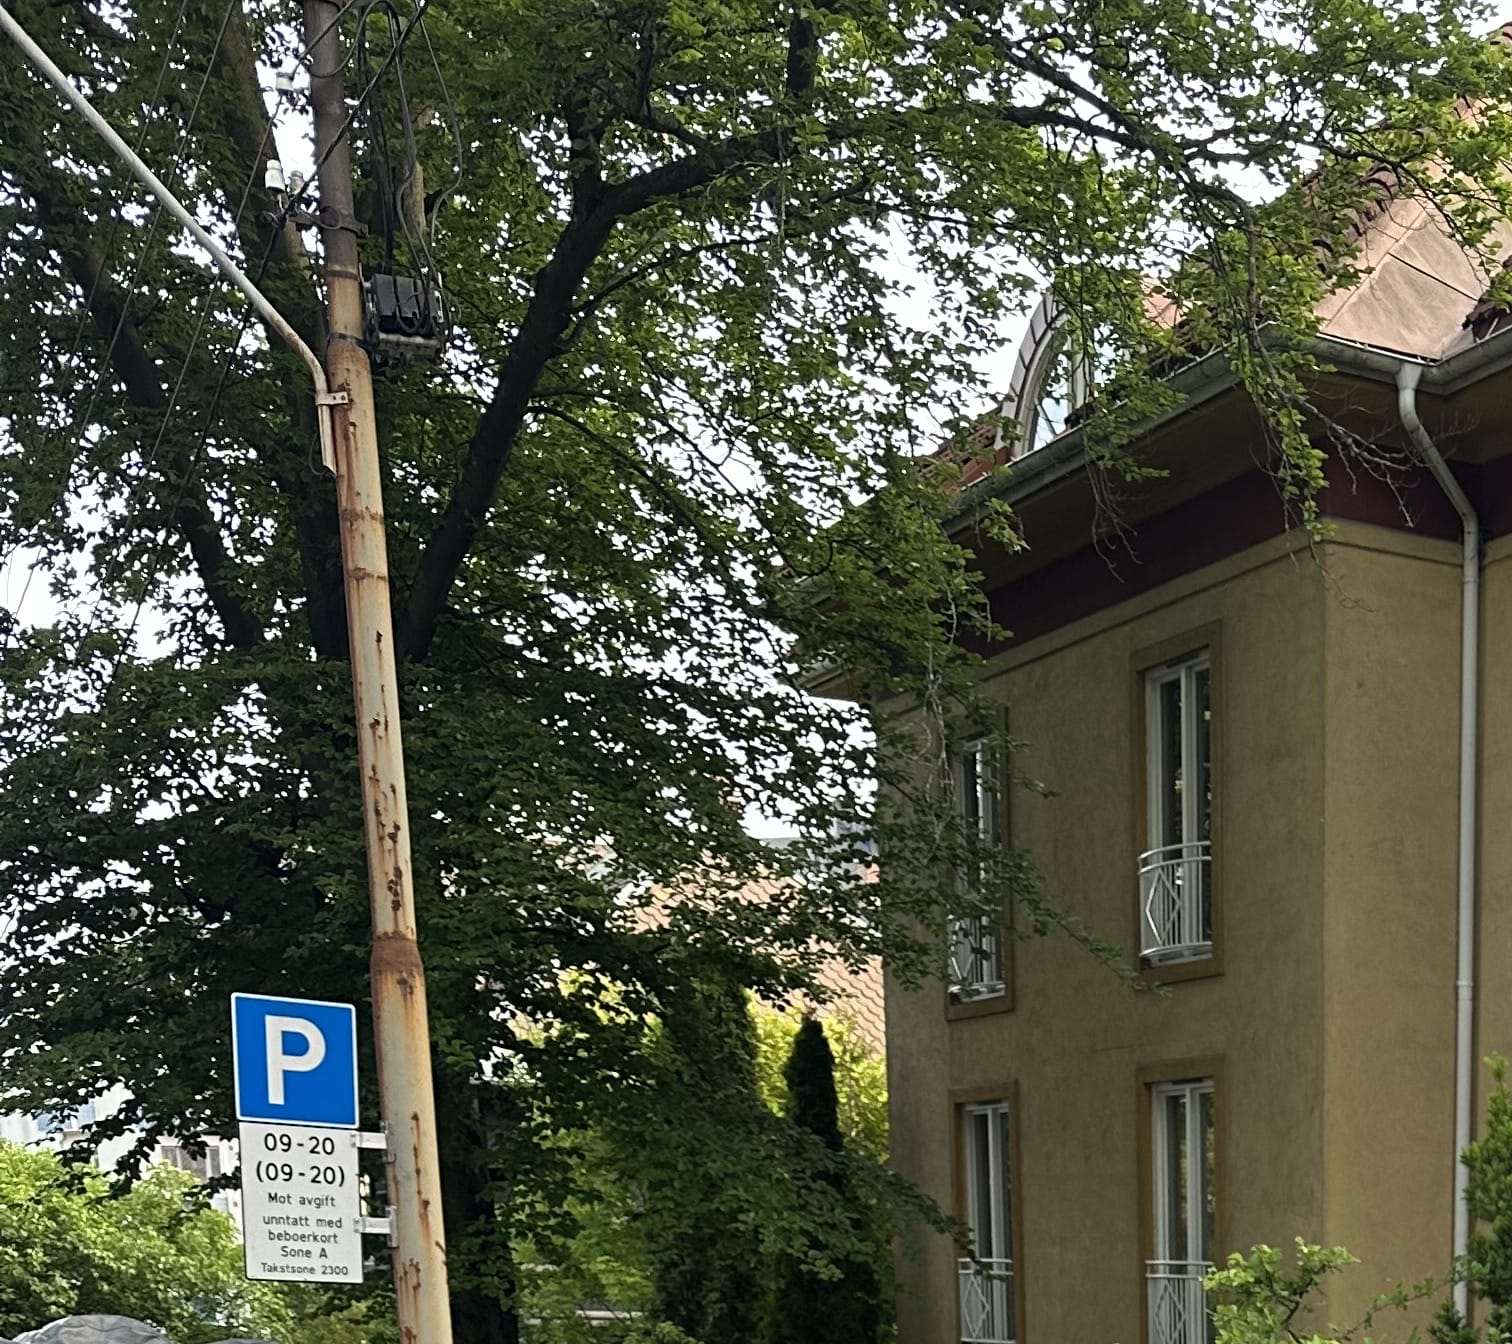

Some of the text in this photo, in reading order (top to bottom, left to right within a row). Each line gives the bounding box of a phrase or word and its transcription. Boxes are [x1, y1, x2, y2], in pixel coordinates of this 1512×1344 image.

[265, 1014, 326, 1105] P
[268, 1193, 336, 1209] Mot avgift
[263, 1214, 342, 1228] unntatt med
[268, 1229, 338, 1244] beboerkort
[280, 1246, 328, 1259] Sone A
[261, 1263, 348, 1276] Takstsone 2300
